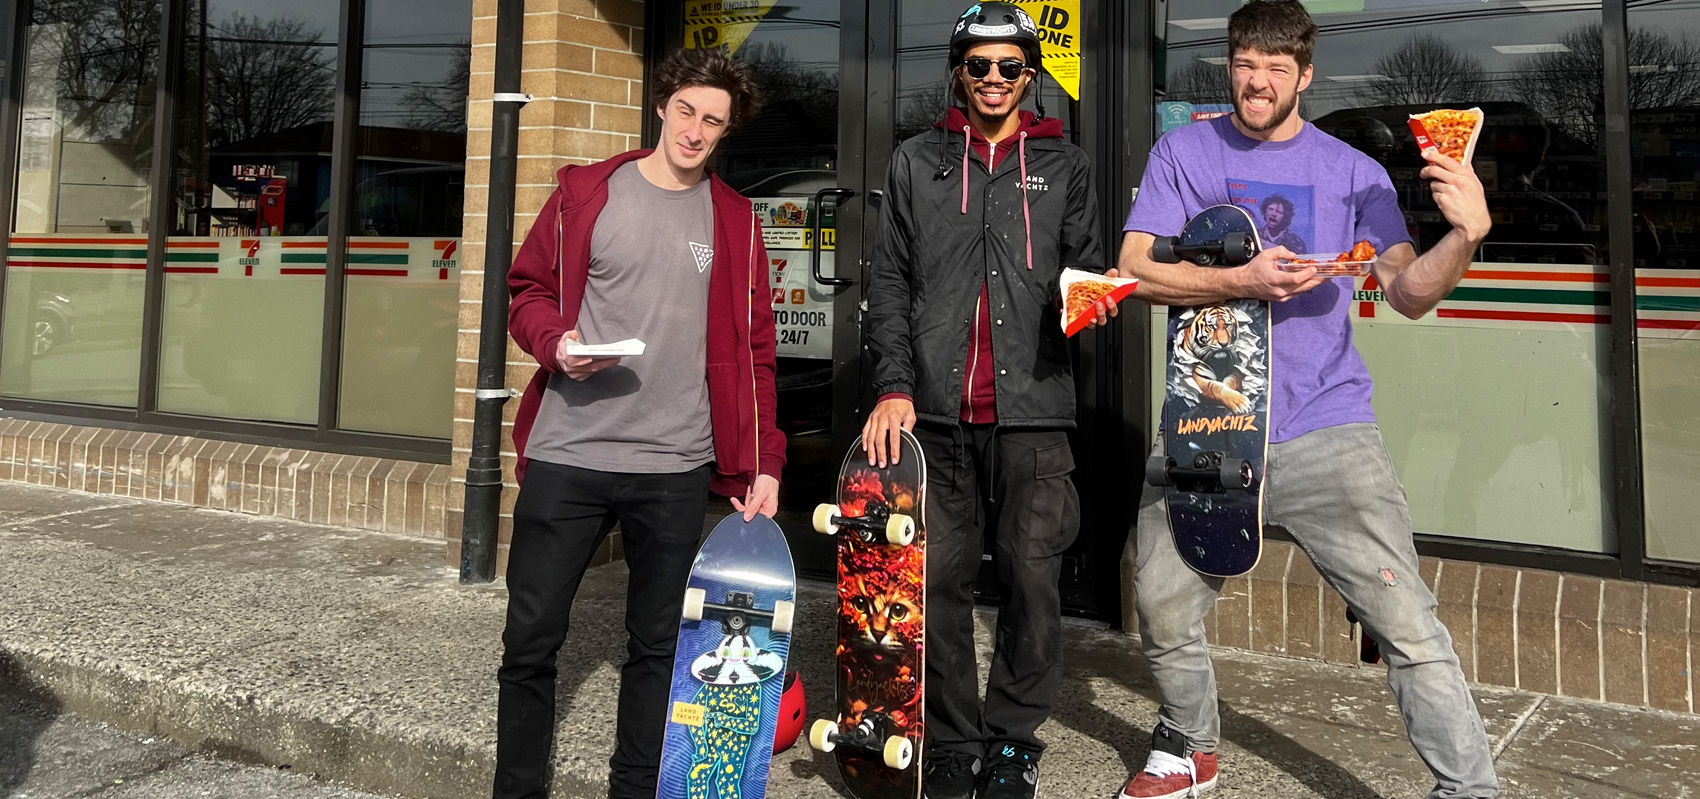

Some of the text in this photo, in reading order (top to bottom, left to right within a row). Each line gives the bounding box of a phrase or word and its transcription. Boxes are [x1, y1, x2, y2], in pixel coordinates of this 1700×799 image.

[701, 0, 759, 12] WE ID UNDER 30
[1039, 4, 1070, 30] ID
[693, 26, 718, 49] ID
[1026, 175, 1044, 183] AND
[754, 202, 769, 212] OFF
[804, 231, 835, 246] PLL
[241, 240, 260, 276] 7
[434, 240, 456, 280] 7
[1352, 290, 1386, 302] LEVE
[791, 310, 826, 326] DOOR
[780, 329, 810, 345] 24/7
[1177, 414, 1259, 436] LANDYACHTZ
[676, 713, 700, 721] YACHTZ
